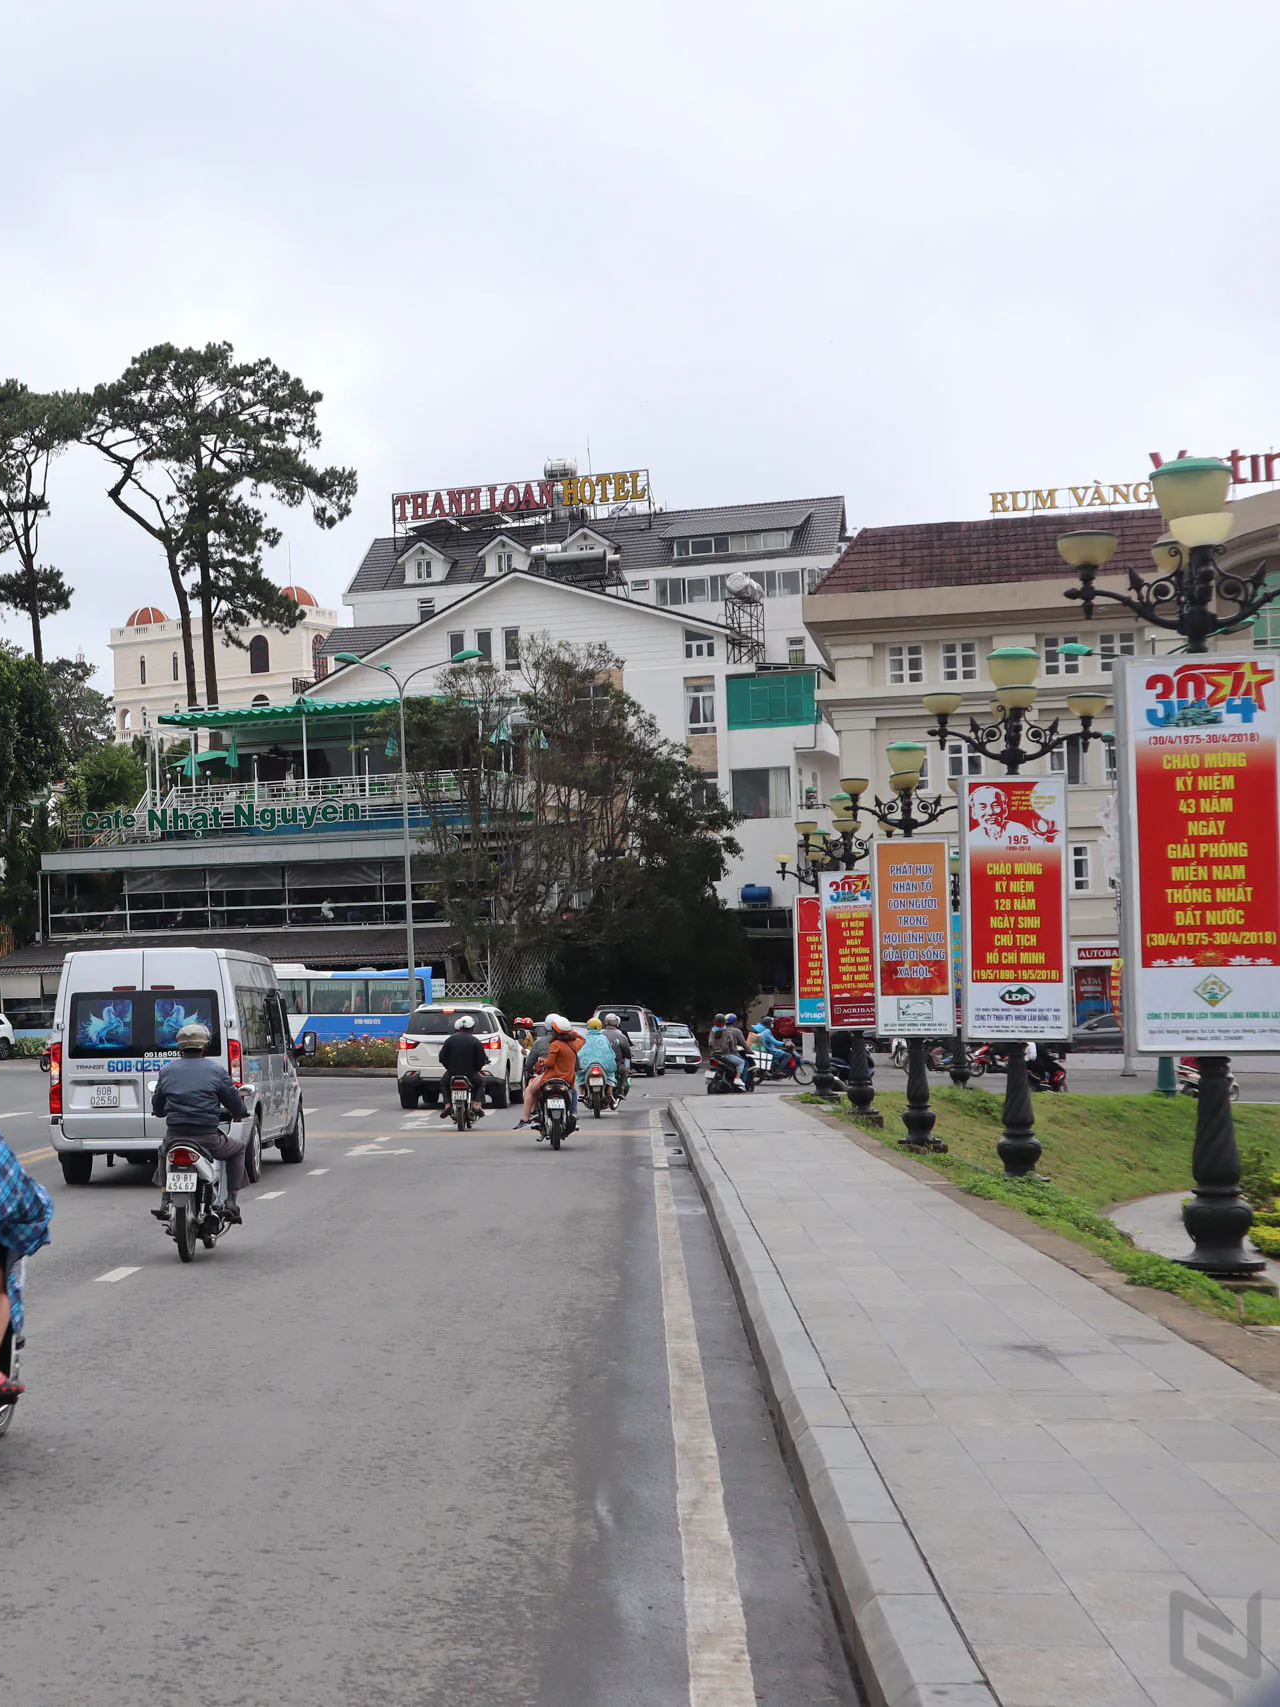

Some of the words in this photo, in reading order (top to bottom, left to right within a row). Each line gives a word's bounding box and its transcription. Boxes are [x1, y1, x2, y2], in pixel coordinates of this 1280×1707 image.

[395, 486, 482, 522] THANH
[487, 480, 555, 513] LOAN
[561, 472, 647, 506] HOTEL
[989, 488, 1058, 513] RUM
[1068, 480, 1155, 508] VÀNG
[1148, 732, 1260, 746] (30/4/1975-30/4/2018)
[1162, 751, 1200, 769] CHÀO
[1204, 750, 1248, 768] MỪNG
[1176, 771, 1194, 792] KỶ
[1198, 772, 1235, 793] NIỆM
[1179, 798, 1196, 813] 43
[1200, 794, 1234, 813] NĂM
[148, 807, 223, 839] Nhật
[234, 798, 361, 831] Nguyên
[1188, 817, 1226, 836] NGÀY
[1008, 835, 1029, 845] 19/5
[1167, 838, 1196, 859] GIẢI
[1200, 840, 1248, 858] PHÓNG
[889, 863, 913, 876] PHÁT
[915, 863, 934, 875] HUY
[987, 861, 1012, 875] CHÀO
[1014, 860, 1043, 875] MỪNG
[1212, 864, 1246, 880] NAM
[892, 879, 919, 892] NHÂN
[920, 878, 933, 892] TỐ
[995, 876, 1007, 893] KỶ
[1010, 878, 1034, 894] NIỆM
[1165, 883, 1212, 904] THỐNG
[1216, 881, 1253, 902] NHẤT
[888, 898, 907, 910] CON
[908, 897, 938, 910] NGƯỜI
[994, 899, 1011, 910] 128
[1014, 895, 1036, 910] NĂM
[898, 915, 929, 927] TRONG
[990, 914, 1015, 929] NGÀY
[1018, 916, 1041, 929] SINH
[1175, 906, 1202, 926] ĐẤT
[1206, 907, 1245, 926] NƯỚC
[846, 938, 861, 946] NGÀY
[883, 932, 901, 945] MỌI
[902, 931, 926, 944] LĨNH
[926, 931, 945, 945] VỰC
[994, 930, 1013, 946] CHỦ
[1016, 934, 1037, 949] TỊCH
[1147, 931, 1277, 947] (30/4/1975-30/4/2018)
[883, 947, 902, 961] CỦA
[902, 948, 919, 961] ĐỜI
[921, 946, 946, 961] SỐNG
[1001, 949, 1017, 964] CHÍ
[1020, 952, 1046, 964] MINH
[973, 969, 1060, 981] (19/5/1890-19/5/2018)
[1081, 977, 1102, 985] ATM
[1005, 993, 1031, 1002] LDA
[96, 1087, 112, 1095] 60B
[90, 1095, 118, 1105] 025.50
[172, 1174, 192, 1182] 49-B1
[168, 1182, 195, 1190] 454.67
